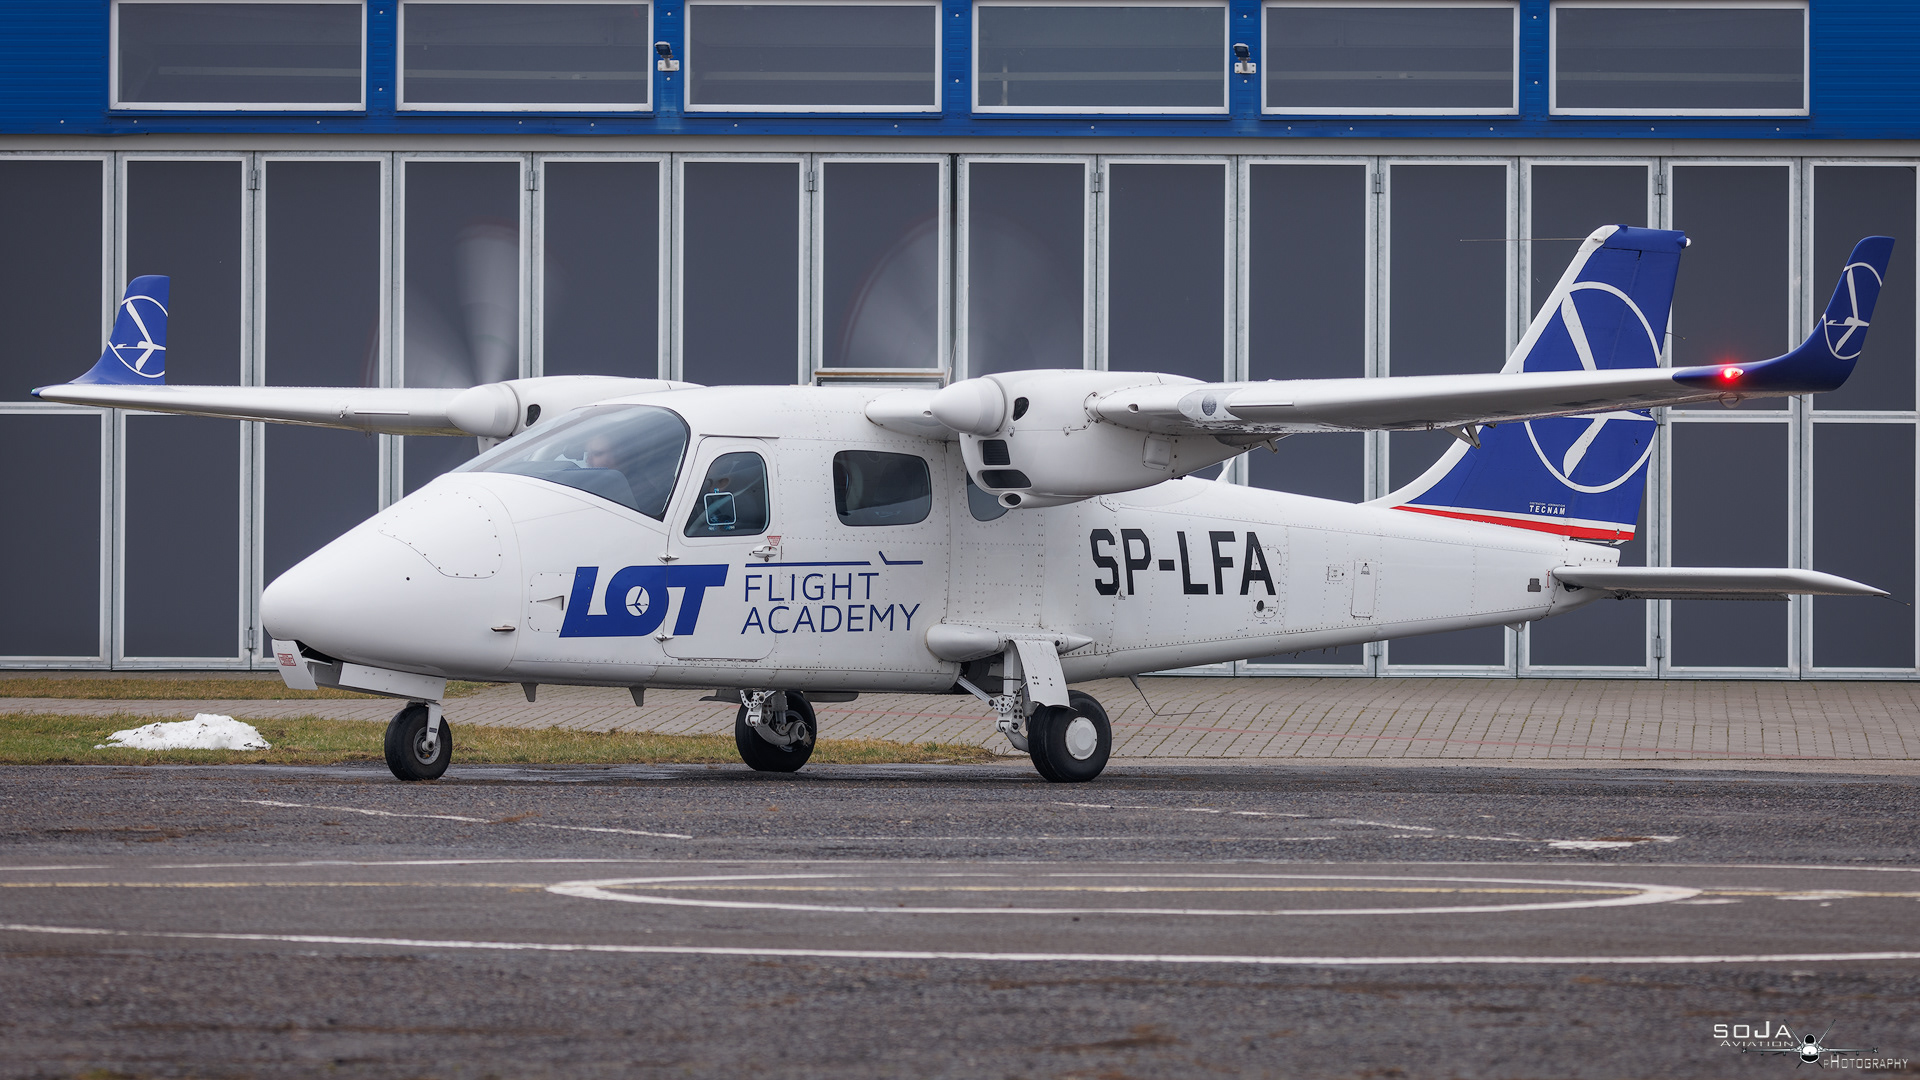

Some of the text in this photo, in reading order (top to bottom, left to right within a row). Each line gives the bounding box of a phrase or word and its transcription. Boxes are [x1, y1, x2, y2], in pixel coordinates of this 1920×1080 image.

[1529, 505, 1566, 515] TECNAM
[1089, 528, 1277, 596] SP-LFA
[559, 564, 729, 638] LOT
[744, 572, 880, 602] FLIGHT
[741, 603, 921, 635] ACADEMY
